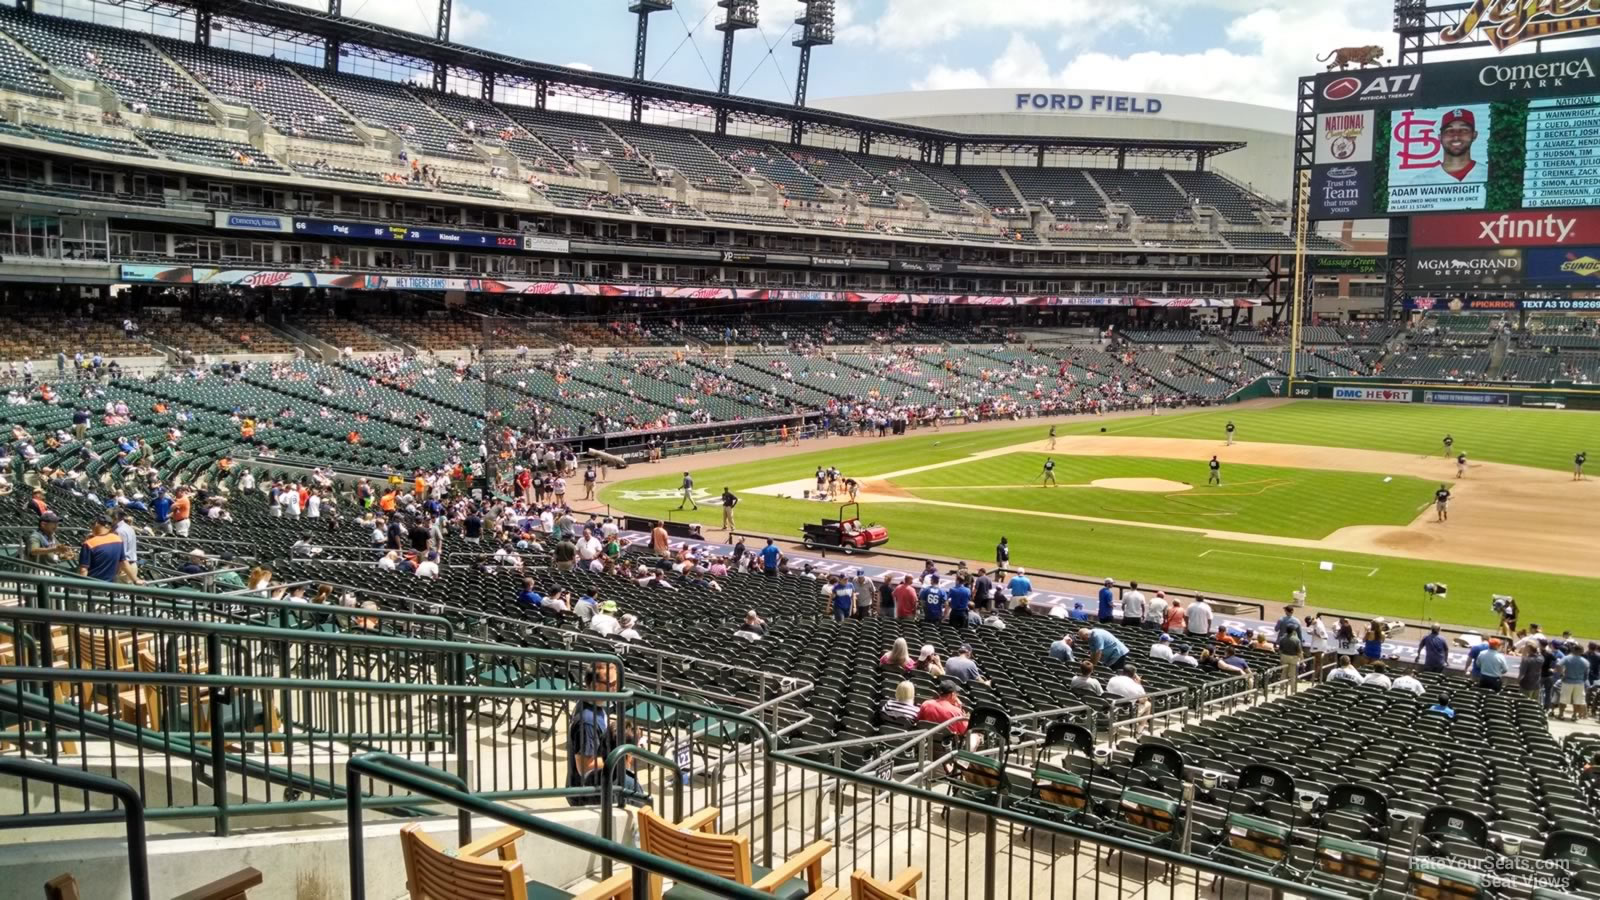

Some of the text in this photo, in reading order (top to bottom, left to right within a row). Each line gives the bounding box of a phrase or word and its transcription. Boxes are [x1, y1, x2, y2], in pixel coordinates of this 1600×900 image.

[1361, 74, 1420, 94] ATI
[1509, 77, 1563, 89] PARK
[1016, 93, 1162, 113] FORD FIELD
[1556, 97, 1596, 106] NATIONAL
[1545, 109, 1597, 118] WAINWRIGHT,
[1325, 114, 1364, 131] NATIONAL
[1544, 121, 1571, 129] CUETO,
[1544, 130, 1578, 138] BECKETT,
[1580, 128, 1599, 137] JOSH
[1543, 140, 1576, 148] ALVAREZ,
[1579, 148, 1593, 156] TIM
[1543, 160, 1578, 168] TEHERAN,
[1542, 170, 1577, 178] GREINKE,
[1578, 168, 1598, 176] ZACK
[1541, 180, 1568, 188] SIMON,
[1323, 187, 1359, 199] Team
[1391, 185, 1480, 196] ADAM WAINWRIGHT
[1540, 189, 1591, 197] ZIMMERMANN,
[333, 225, 349, 234] Puig
[1479, 214, 1576, 243] xfinity
[497, 237, 517, 245] 12:21
[1318, 257, 1375, 267] Massage Green
[1417, 259, 1517, 269] MGM GRAND
[243, 272, 291, 287] Miller
[396, 278, 407, 286] HEY
[409, 278, 429, 287] TIGERS
[1572, 300, 1600, 308] 89269
[1336, 389, 1361, 398] DMC
[928, 594, 939, 604] 66
